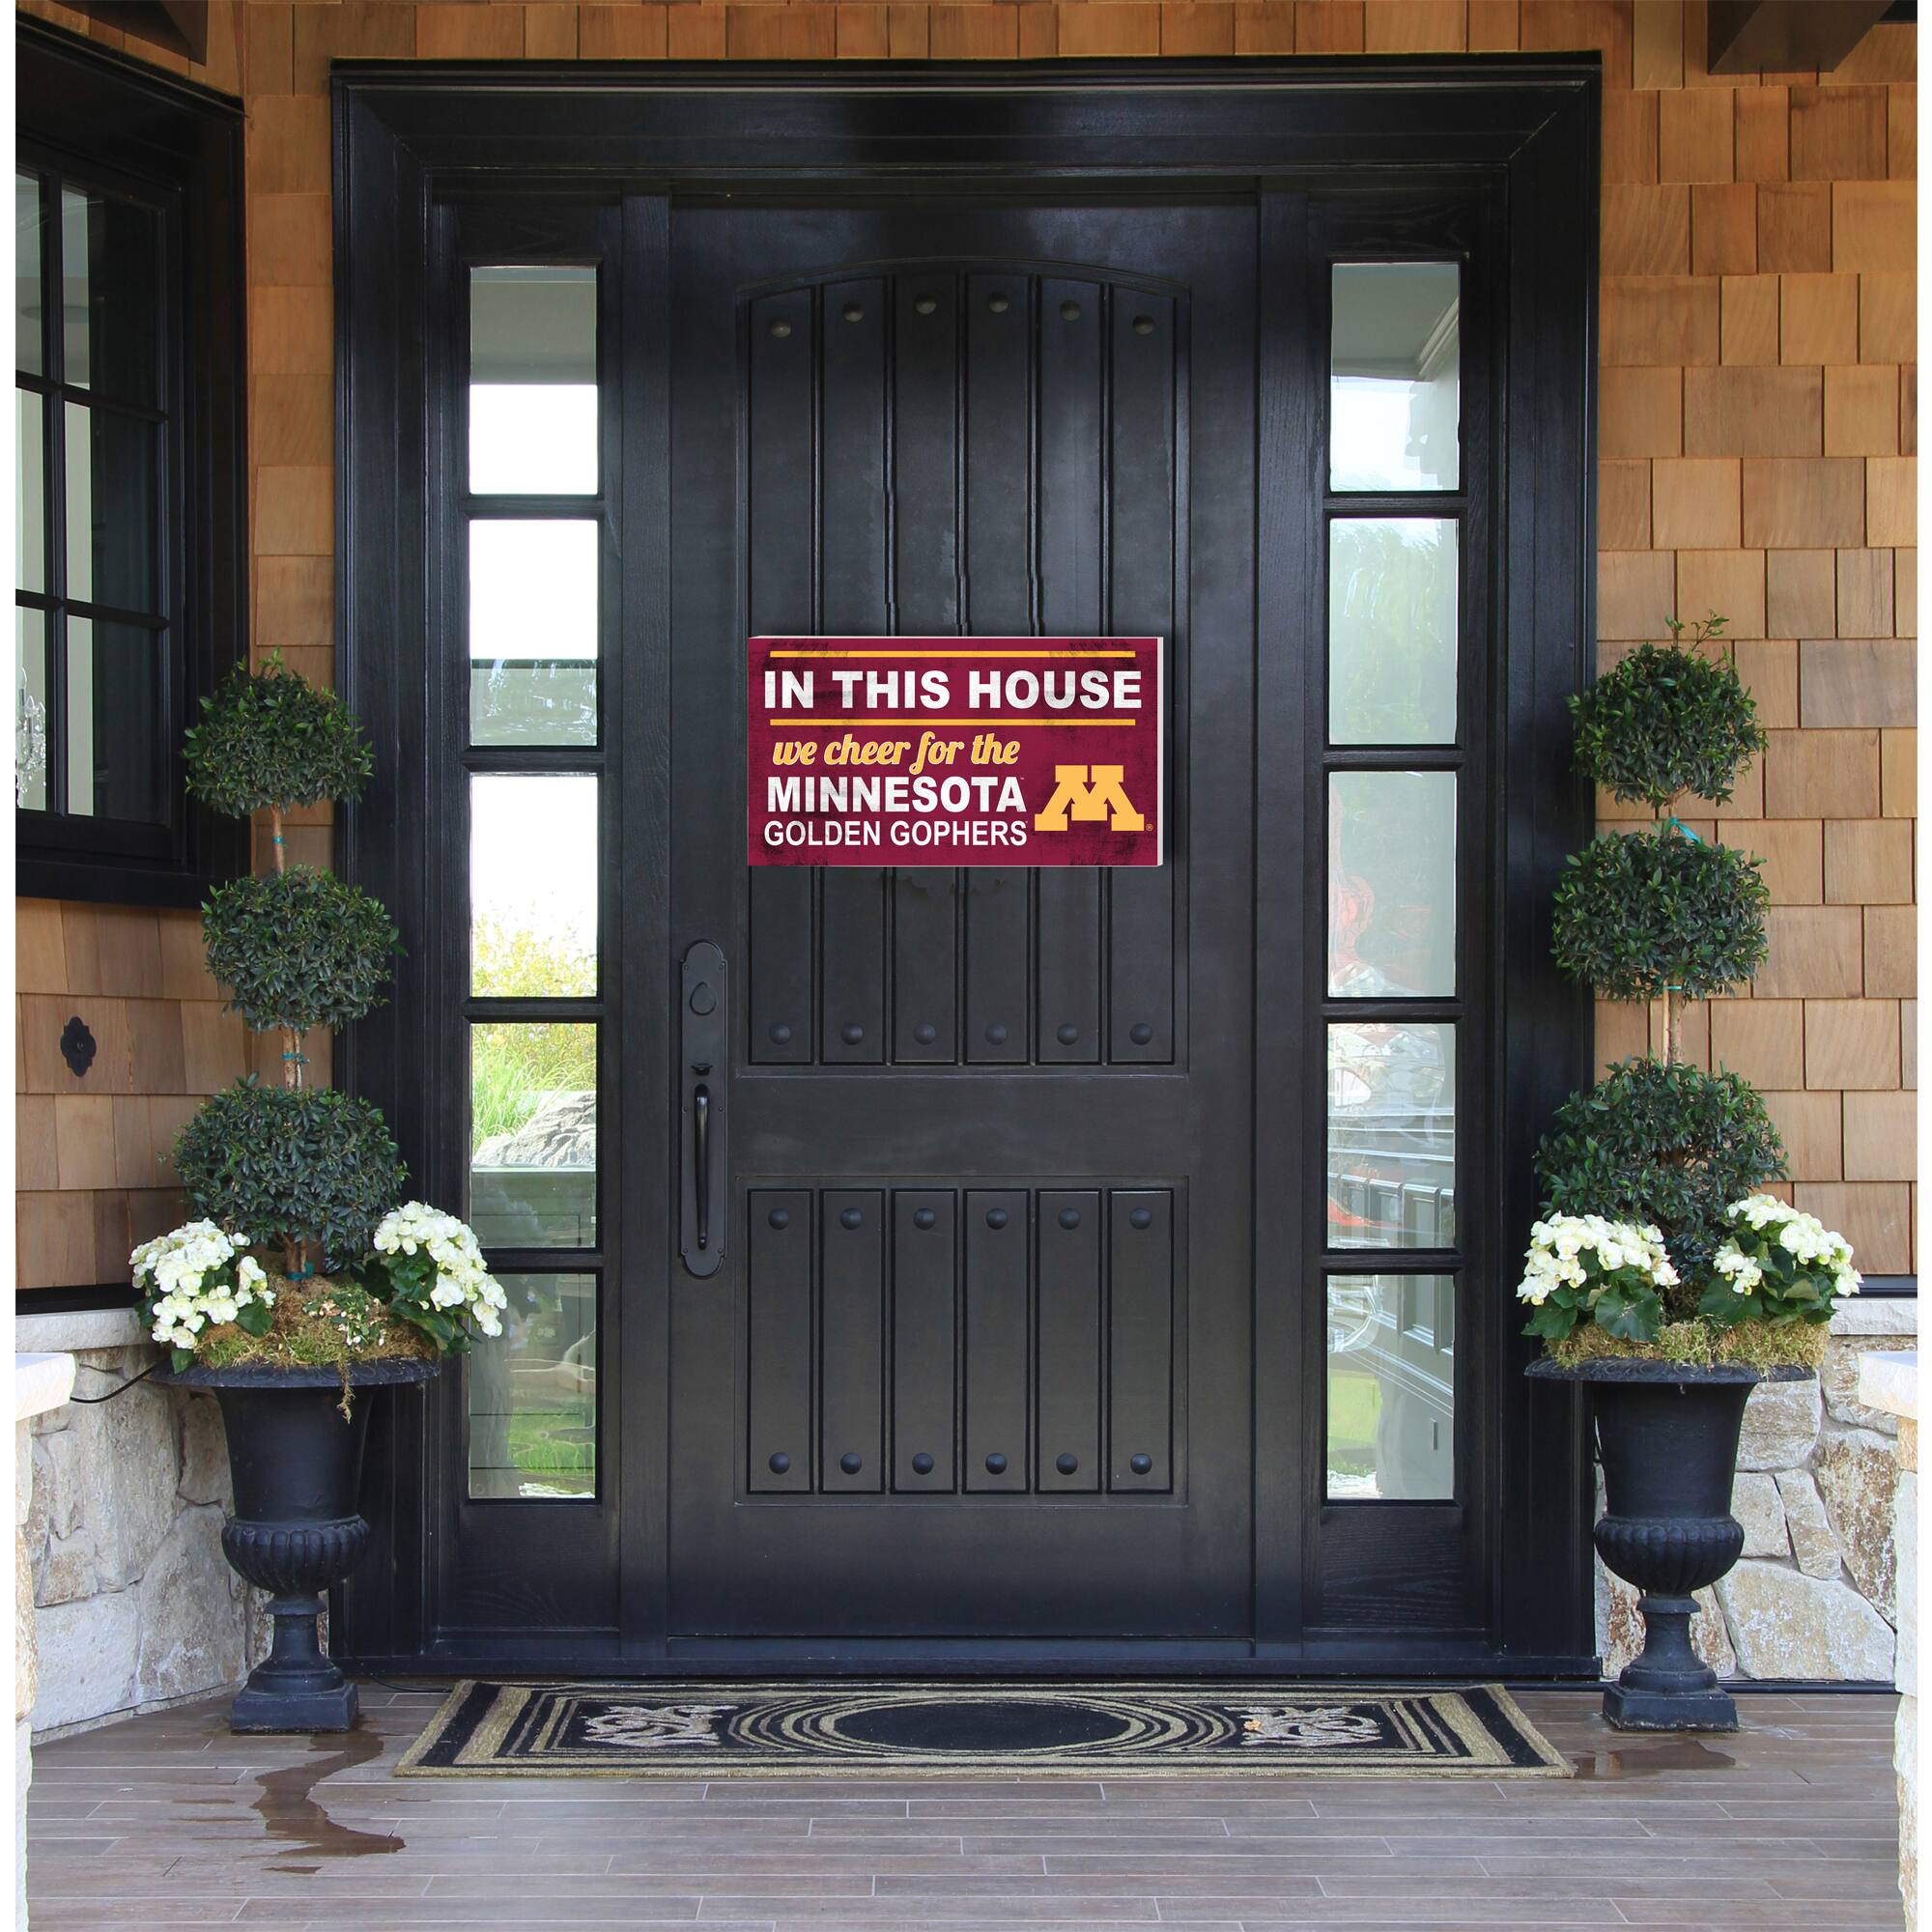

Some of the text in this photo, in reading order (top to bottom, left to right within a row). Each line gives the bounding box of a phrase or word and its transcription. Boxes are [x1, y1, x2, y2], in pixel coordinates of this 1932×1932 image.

[764, 670, 1142, 709] IN THIS HOUSE
[772, 730, 1021, 775] we cheer for the
[767, 776, 1028, 812] MINNESOTA
[764, 820, 1028, 846] GOLDEN GOPHERS
